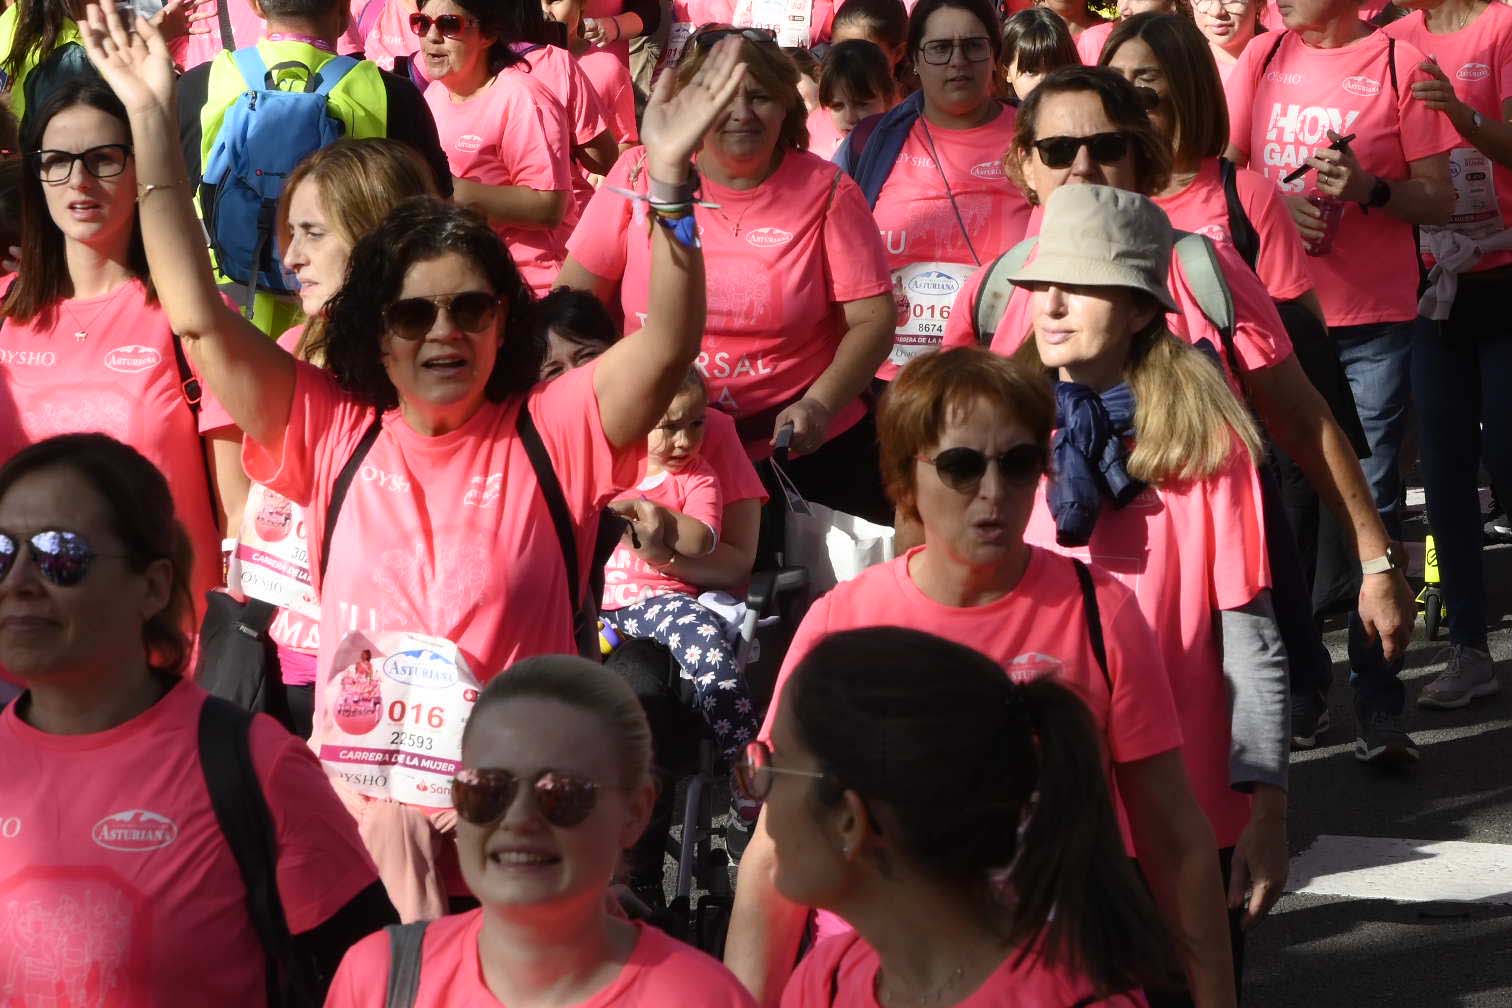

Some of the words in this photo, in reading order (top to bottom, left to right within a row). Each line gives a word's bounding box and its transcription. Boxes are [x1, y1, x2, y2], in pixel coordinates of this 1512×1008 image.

[1266, 103, 1359, 144] HOY
[910, 279, 956, 291] ASTURIANA
[912, 303, 950, 321] 016
[917, 323, 942, 334] 8674
[695, 351, 773, 380] RSAL
[387, 662, 455, 687] ASTURIANA
[388, 698, 446, 730] 016
[390, 730, 434, 752] 22593
[338, 750, 391, 765] CARRERA
[404, 755, 420, 769] LA
[420, 758, 456, 773] MUJER
[98, 825, 172, 841] ASTURIANA
